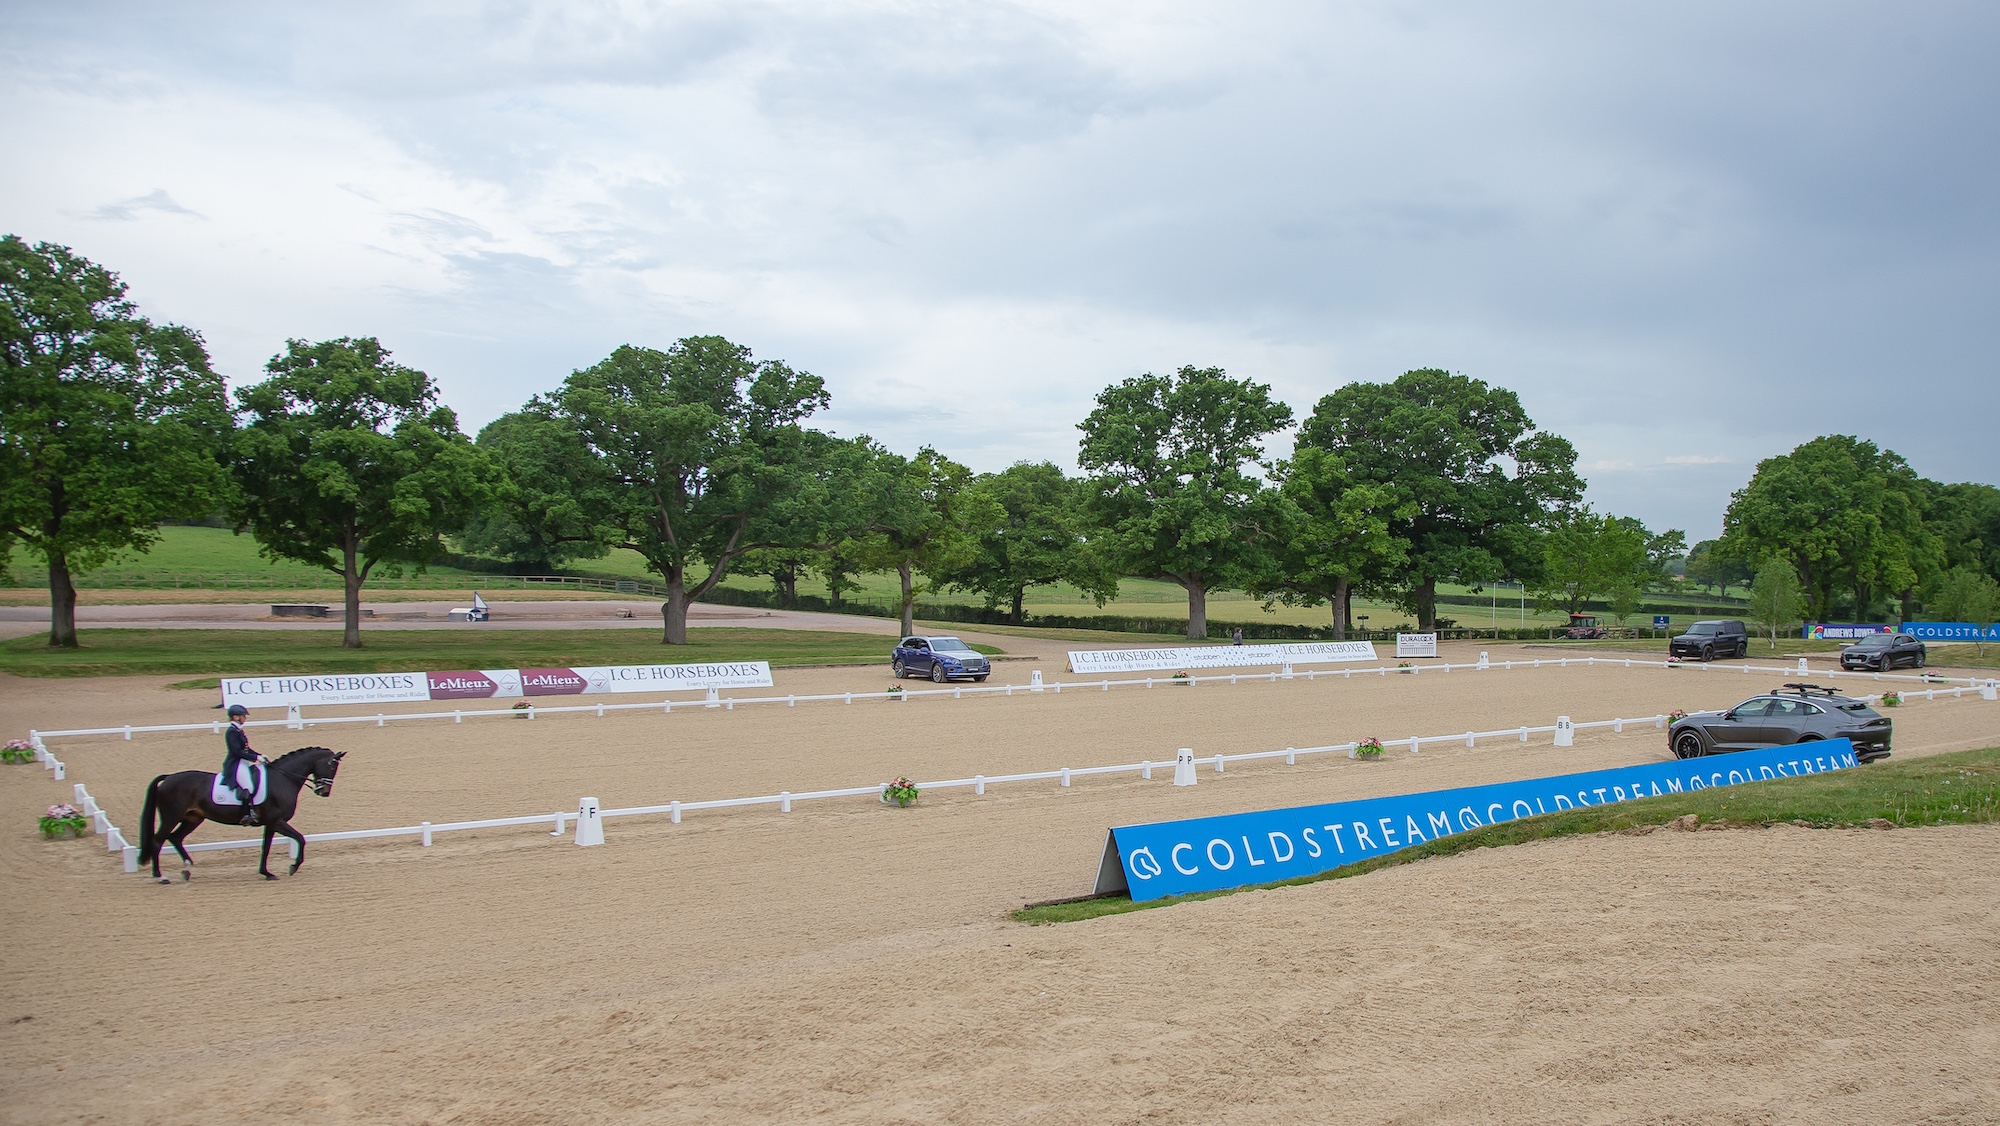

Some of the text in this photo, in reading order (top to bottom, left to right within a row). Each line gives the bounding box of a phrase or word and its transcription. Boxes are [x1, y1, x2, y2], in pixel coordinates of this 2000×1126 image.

[1823, 628, 1853, 638] ANDREWS
[1917, 627, 2000, 637] COLDSTREA
[1305, 642, 1369, 654] HORSEBOXES
[1074, 649, 1178, 664] I.C.E HORSEBOXES
[610, 664, 760, 681] I.C.E HORSEBOXES
[226, 675, 414, 695] I.C.E HORSEBOXES
[429, 678, 491, 690] LeMieux
[522, 674, 581, 686] LeMieux
[1558, 721, 1563, 729] B
[1179, 755, 1183, 764] P
[1187, 755, 1192, 764] P
[1711, 753, 1856, 787] COLDSTREAM
[1487, 777, 1684, 824] COLDSTREAM
[589, 807, 596, 818] F
[1171, 810, 1453, 876] COLDSTREAM
